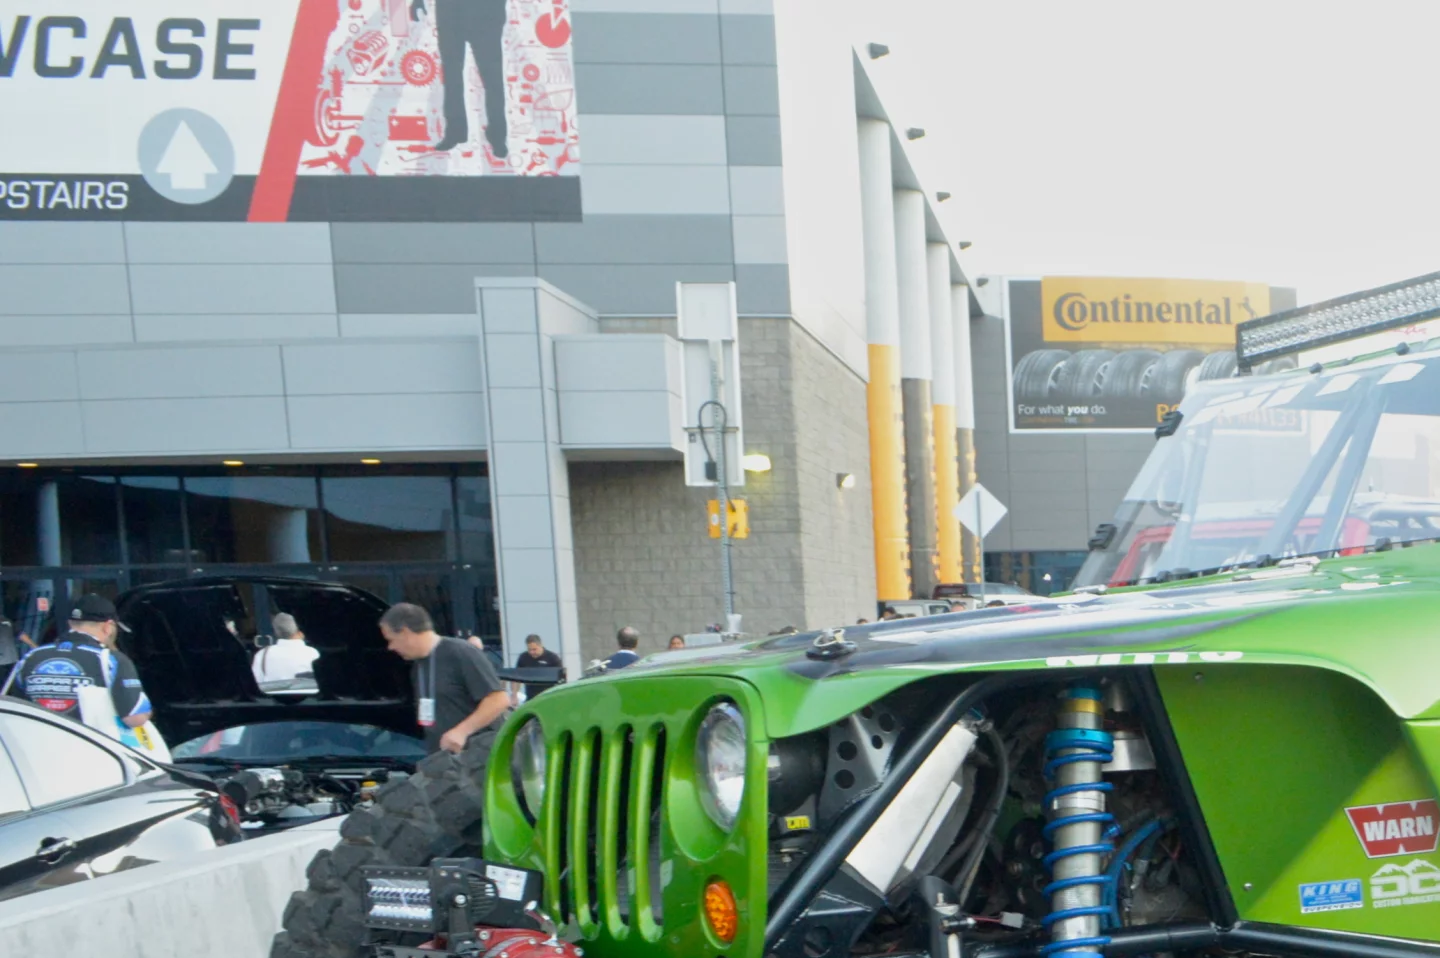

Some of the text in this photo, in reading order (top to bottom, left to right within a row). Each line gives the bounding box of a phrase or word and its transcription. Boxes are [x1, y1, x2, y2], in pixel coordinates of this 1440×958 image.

[1053, 292, 1232, 331] Continental
[1018, 404, 1036, 415] For
[1039, 404, 1064, 415] what
[1067, 406, 1089, 416] you
[1362, 815, 1434, 842] WARN
[1303, 881, 1359, 898] KING
